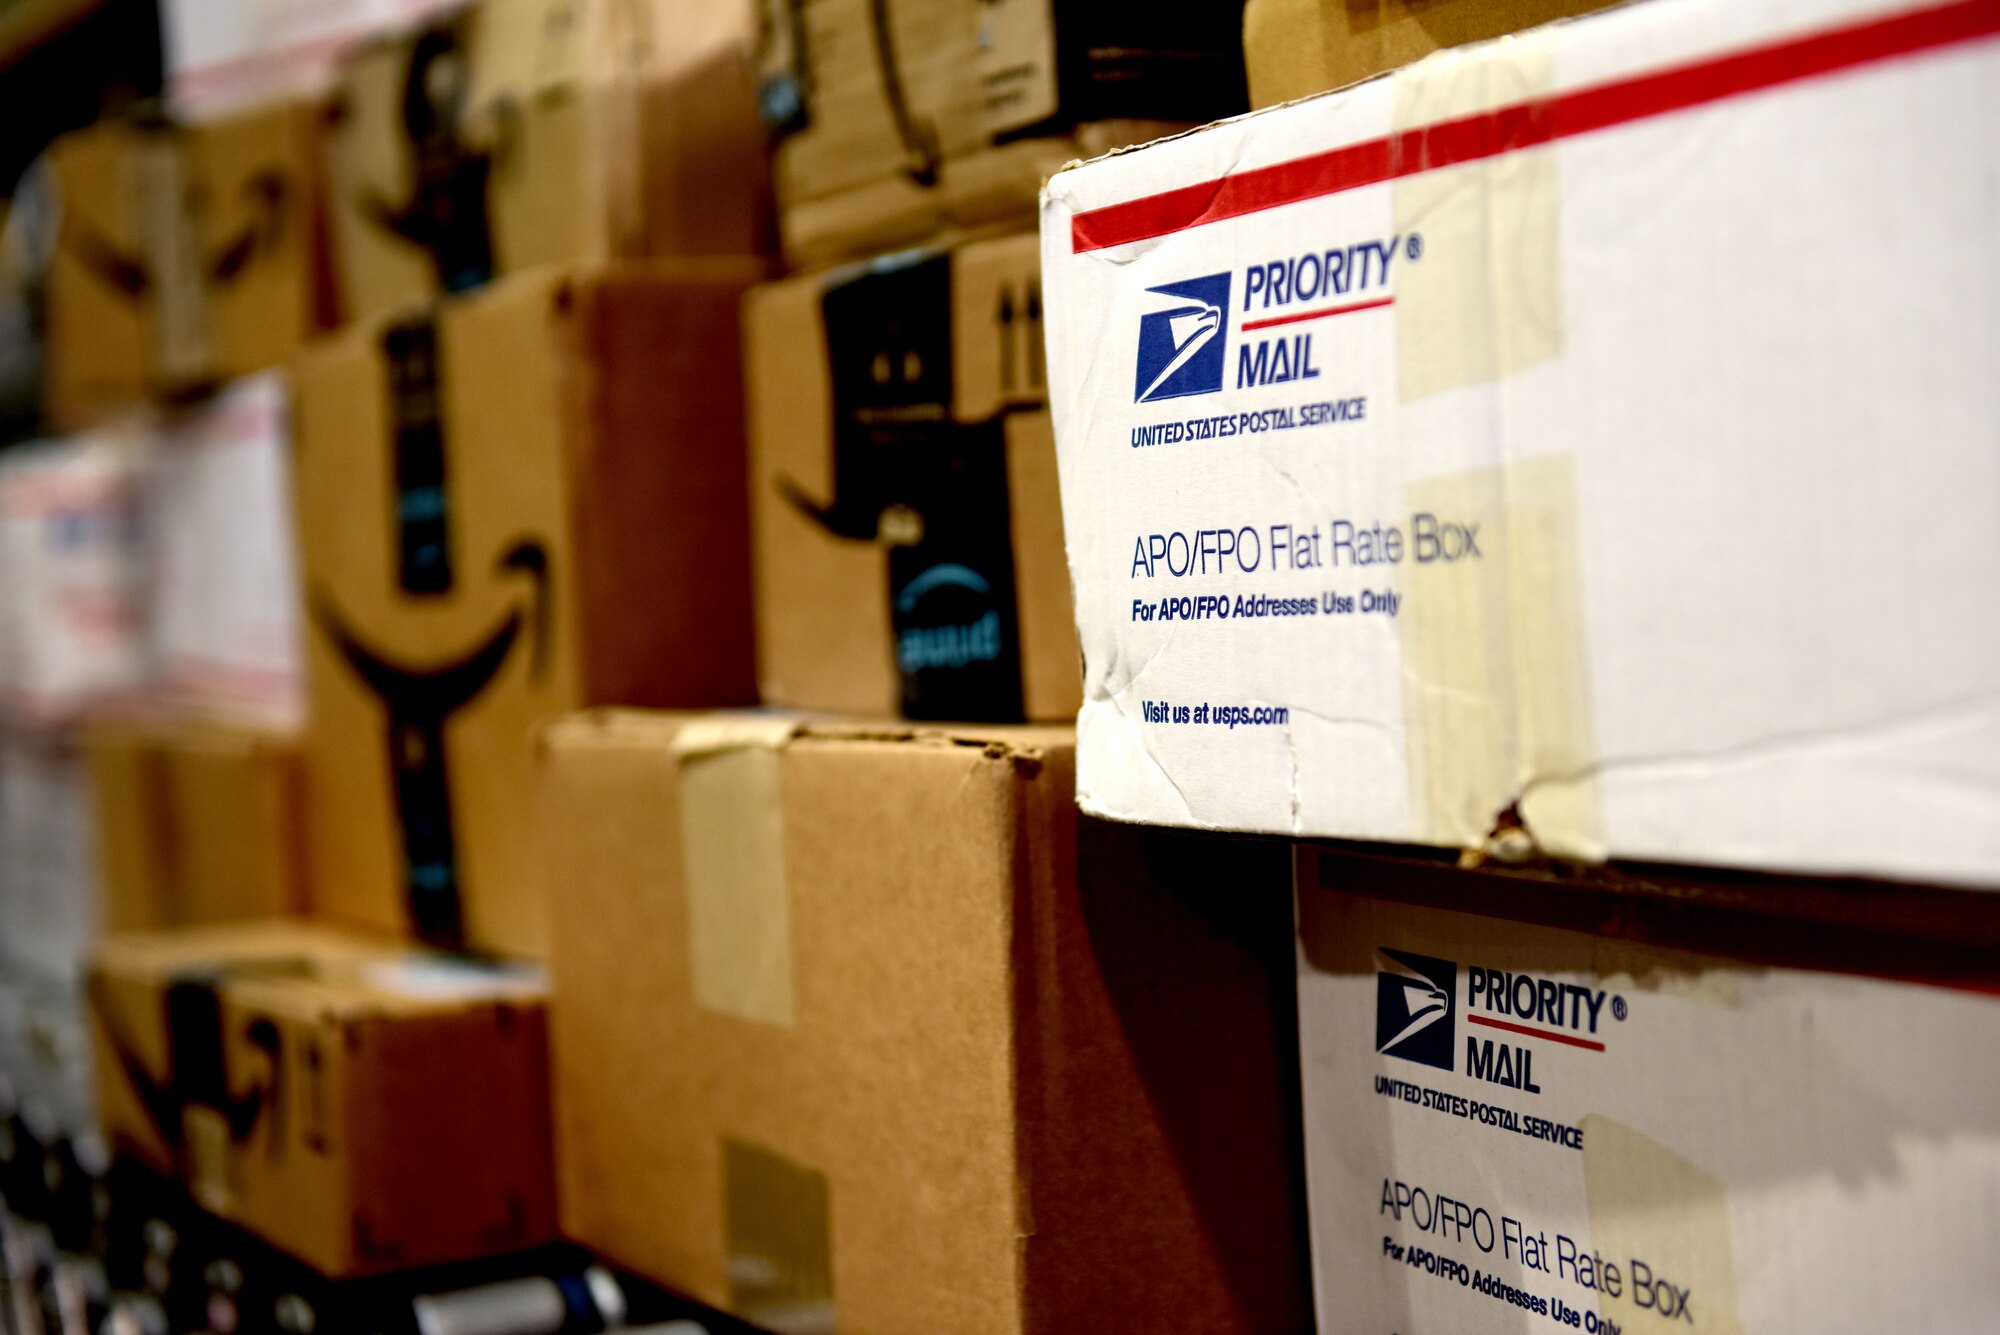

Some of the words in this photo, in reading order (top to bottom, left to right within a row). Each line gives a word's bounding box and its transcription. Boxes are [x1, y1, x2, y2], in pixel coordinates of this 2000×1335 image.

[1244, 234, 1402, 311] PRIORITY
[1237, 333, 1320, 389] MAIL
[1131, 422, 1185, 448] UNITED
[1186, 414, 1237, 441] STATES
[1240, 407, 1297, 436] POSTAL
[1300, 396, 1367, 427] SERVICE
[1131, 526, 1261, 578] APO/FPO
[1270, 524, 1323, 570] Flat
[1332, 520, 1404, 567] Rate
[1411, 513, 1482, 563] Box
[1132, 598, 1157, 621] For
[1158, 594, 1229, 621] APO/FPO
[1232, 591, 1317, 618] Addresses
[1322, 591, 1354, 614] Use
[1360, 588, 1402, 617] Only
[1142, 700, 1169, 724] Visit
[1173, 705, 1190, 724] us
[1193, 703, 1209, 724] at
[1212, 702, 1289, 729] usps.com
[1467, 965, 1606, 1034] PRIORITY
[1466, 1036, 1540, 1094] MAIL
[1375, 1075, 1421, 1105] UNITED
[1422, 1085, 1468, 1118] STATES
[1470, 1099, 1521, 1134] POSTAL
[1522, 1115, 1584, 1150] SERVICE
[1380, 1178, 1494, 1253] APO/FPO
[1502, 1216, 1550, 1273] Flat
[1557, 1235, 1622, 1299] Rate
[1630, 1260, 1693, 1325] Box
[1383, 1237, 1404, 1261] For
[1407, 1245, 1469, 1286] APO/FPO
[1472, 1269, 1547, 1316] Addresses
[1552, 1297, 1581, 1328] Use
